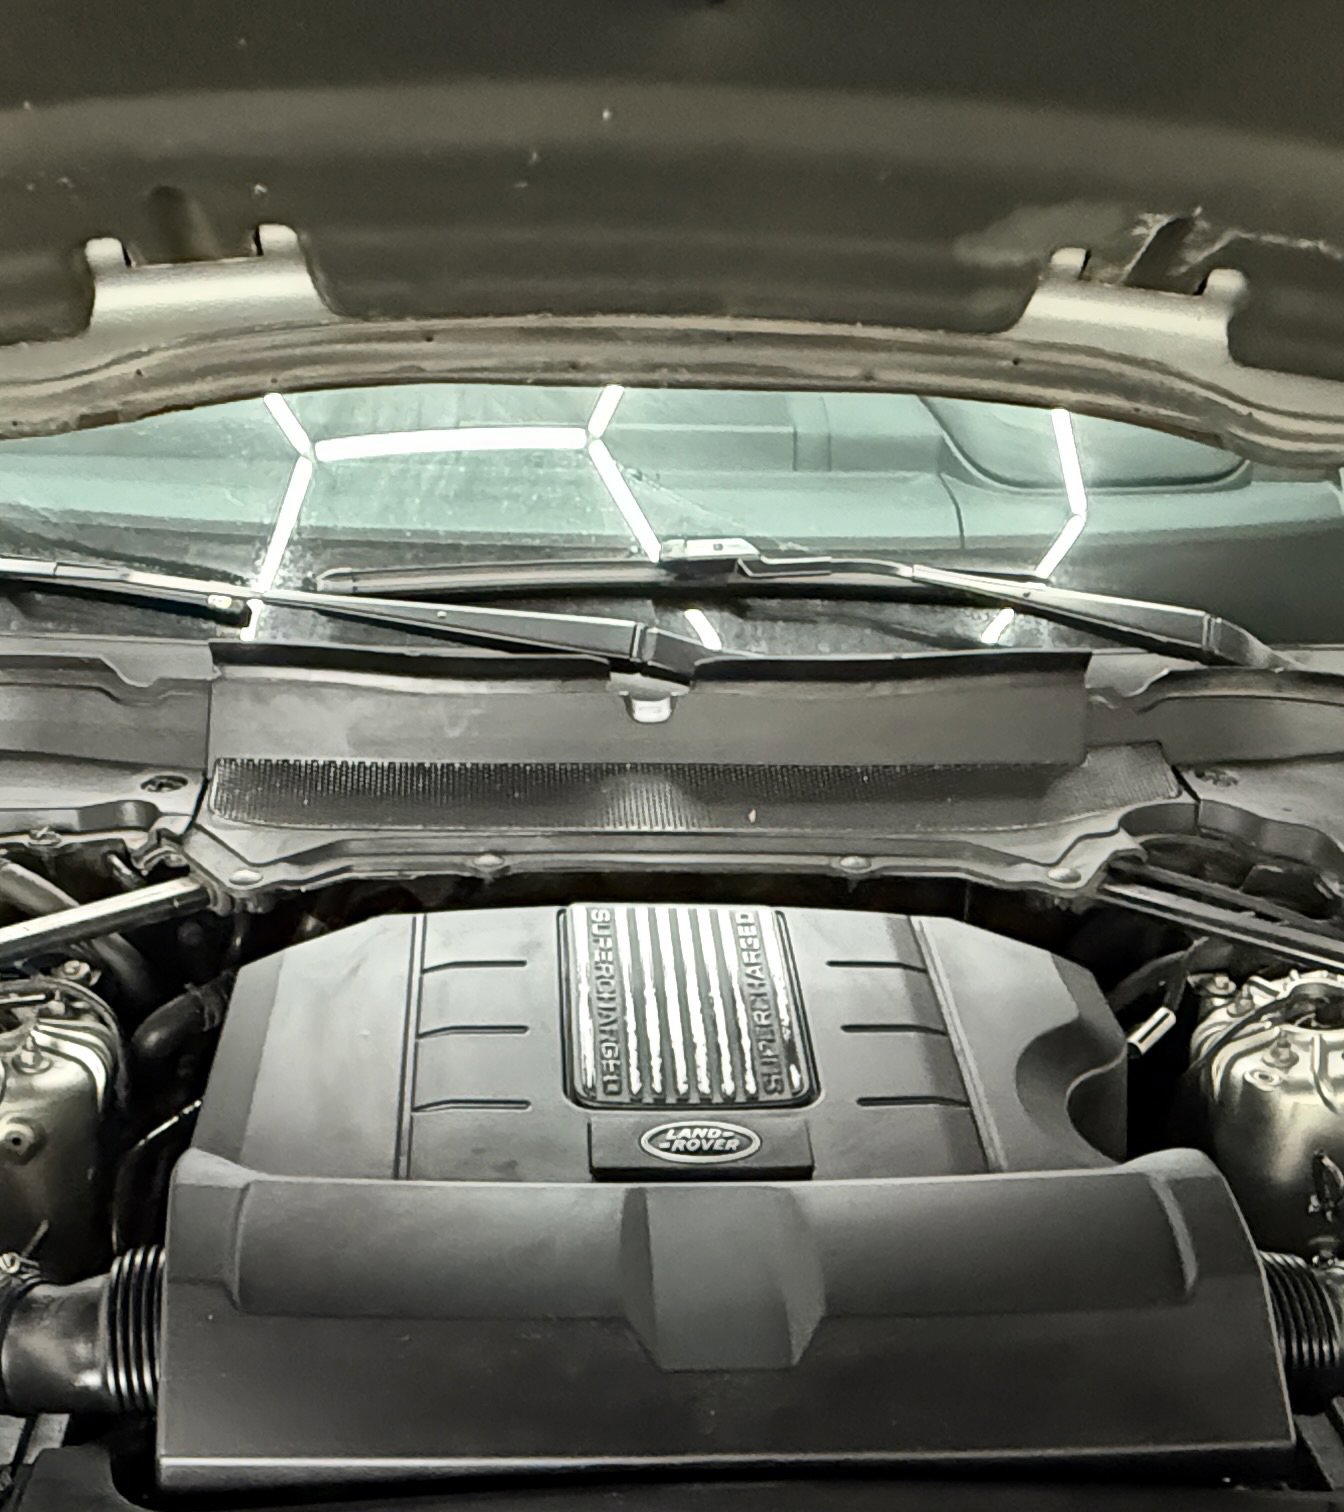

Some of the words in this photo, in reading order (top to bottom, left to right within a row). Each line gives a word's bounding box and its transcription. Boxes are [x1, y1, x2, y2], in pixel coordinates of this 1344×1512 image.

[590, 907, 623, 1096] SUPERCHARGED
[667, 1128, 722, 1140] LAND
[671, 1139, 740, 1152] ROVER
